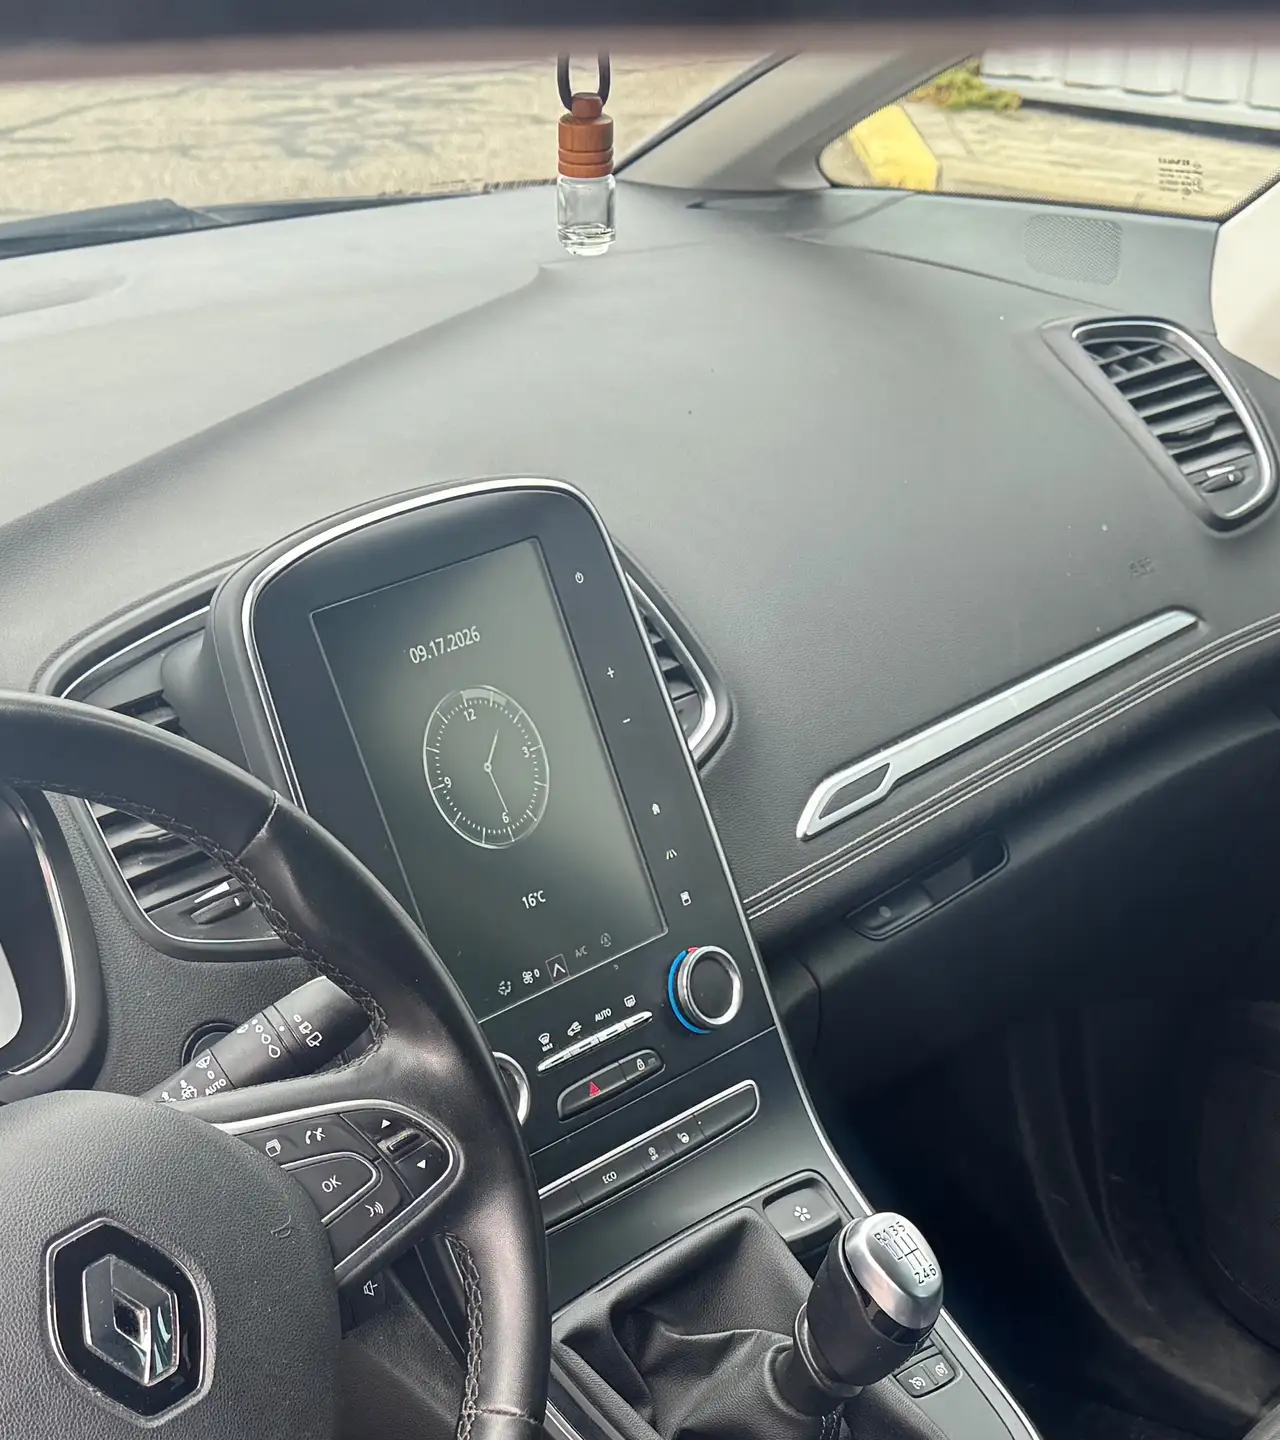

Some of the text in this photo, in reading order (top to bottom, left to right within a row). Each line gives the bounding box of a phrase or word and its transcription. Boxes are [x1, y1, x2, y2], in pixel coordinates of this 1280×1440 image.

[409, 626, 481, 664] 09.17.2026
[463, 708, 477, 722] 12
[521, 746, 530, 758] 3
[443, 776, 452, 789] 9
[501, 811, 510, 824] 6
[521, 890, 547, 909] 16°C
[594, 1008, 612, 1022] AUTO
[205, 1078, 227, 1096] AUTO
[321, 1175, 342, 1194] OK
[601, 1171, 618, 1185] ECO
[888, 1225, 899, 1236] 3
[914, 1272, 925, 1284] 2
[923, 1267, 931, 1279] 4
